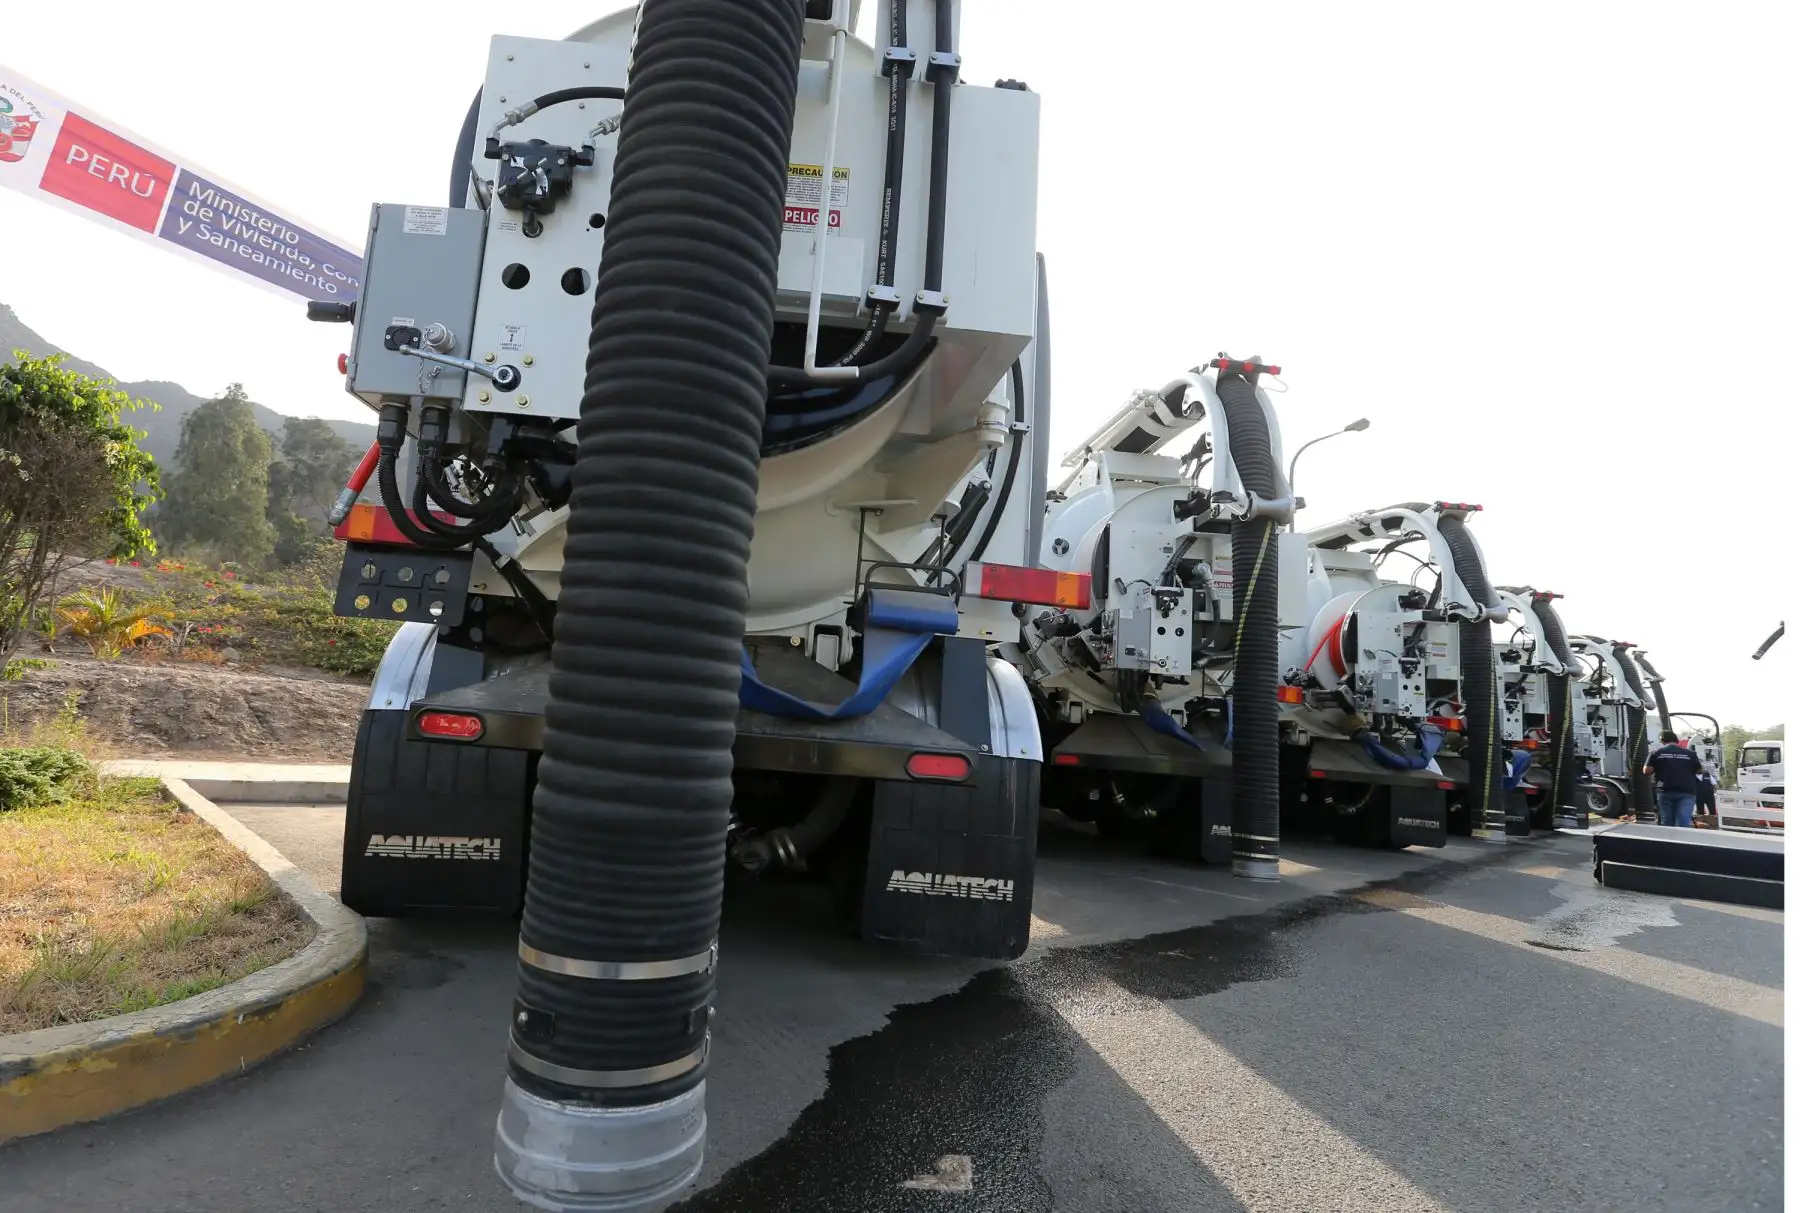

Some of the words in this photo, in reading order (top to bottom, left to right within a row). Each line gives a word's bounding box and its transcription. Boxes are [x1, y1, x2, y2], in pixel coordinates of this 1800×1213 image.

[66, 144, 156, 197] PERÚ
[787, 167, 848, 178] PRECAUIÓN
[189, 181, 299, 244] Ministerio
[784, 210, 838, 225] PELIGO
[179, 216, 192, 235] y
[196, 223, 337, 294] Saneamiento
[184, 199, 213, 222] de
[221, 213, 315, 270] Vivienda,
[322, 263, 359, 287] Con
[365, 834, 500, 860] AQUATECH
[886, 870, 1013, 901] AQUATECH
